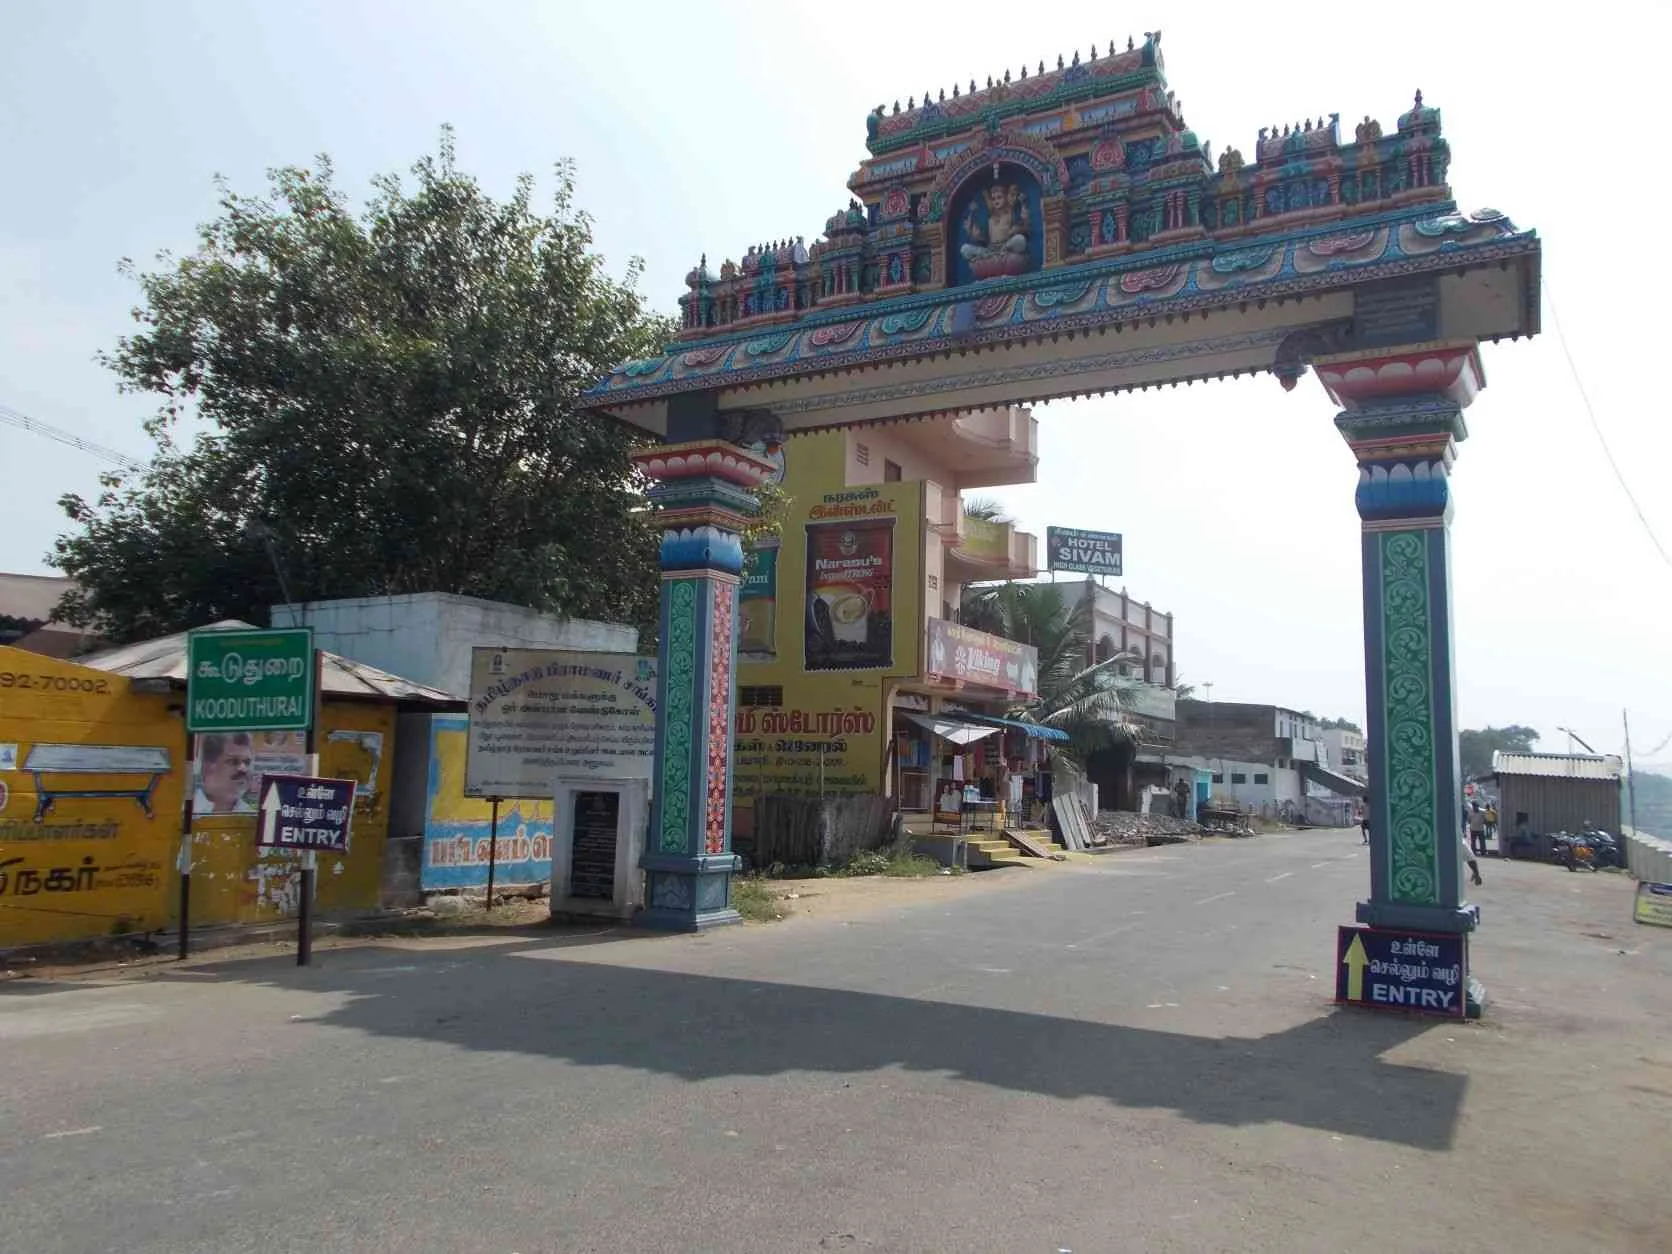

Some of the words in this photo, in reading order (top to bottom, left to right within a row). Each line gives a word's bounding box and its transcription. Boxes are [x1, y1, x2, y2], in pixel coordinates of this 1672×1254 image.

[1068, 537, 1112, 551] HOTEL
[816, 555, 882, 570] Narasu's
[1059, 547, 1120, 566] SIVAM
[197, 652, 304, 686] கூடுதுறை
[195, 696, 302, 719] KOODUTHURAI
[761, 704, 876, 738] ஸ்டோர்ஸ்
[297, 784, 335, 800] உள்ளே
[281, 802, 325, 823] செல்லும்
[327, 806, 348, 825] வழி
[281, 826, 341, 845] ENTRY
[14, 856, 100, 895] நகர்
[1390, 937, 1440, 958] உள்ளே
[1369, 957, 1429, 982] செல்லும்
[1431, 964, 1460, 985] வழி
[1371, 983, 1454, 1009] ENTRY
